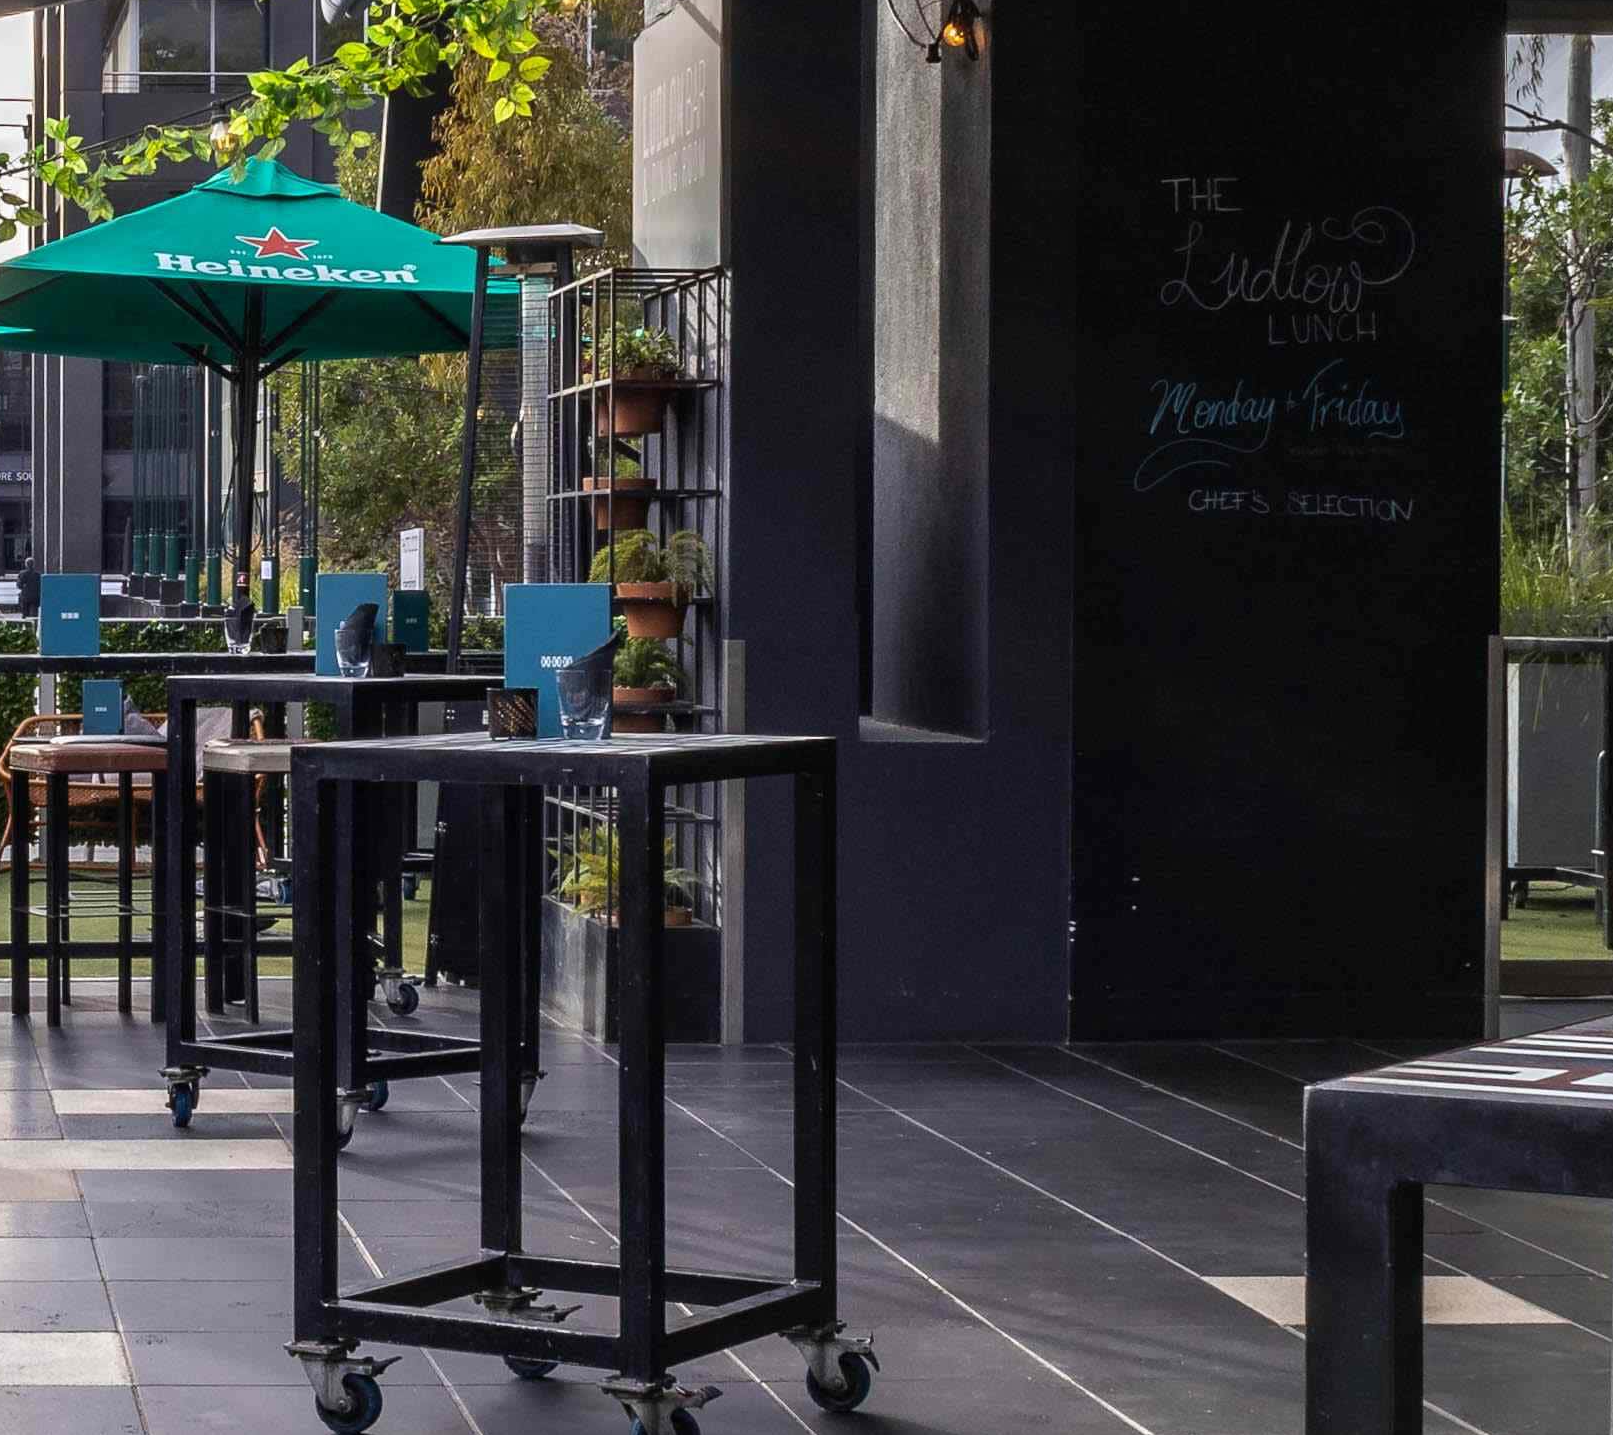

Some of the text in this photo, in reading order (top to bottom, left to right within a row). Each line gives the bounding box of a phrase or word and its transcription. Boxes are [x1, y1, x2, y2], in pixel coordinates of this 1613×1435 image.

[1161, 176, 1244, 212] THE
[153, 251, 419, 284] Heineken
[1160, 206, 1414, 313] Ludlow
[1267, 310, 1379, 345] LUNCH
[1146, 378, 1276, 456] Monday
[1302, 359, 1405, 440] Friday
[1287, 488, 1414, 523] SELECTION
